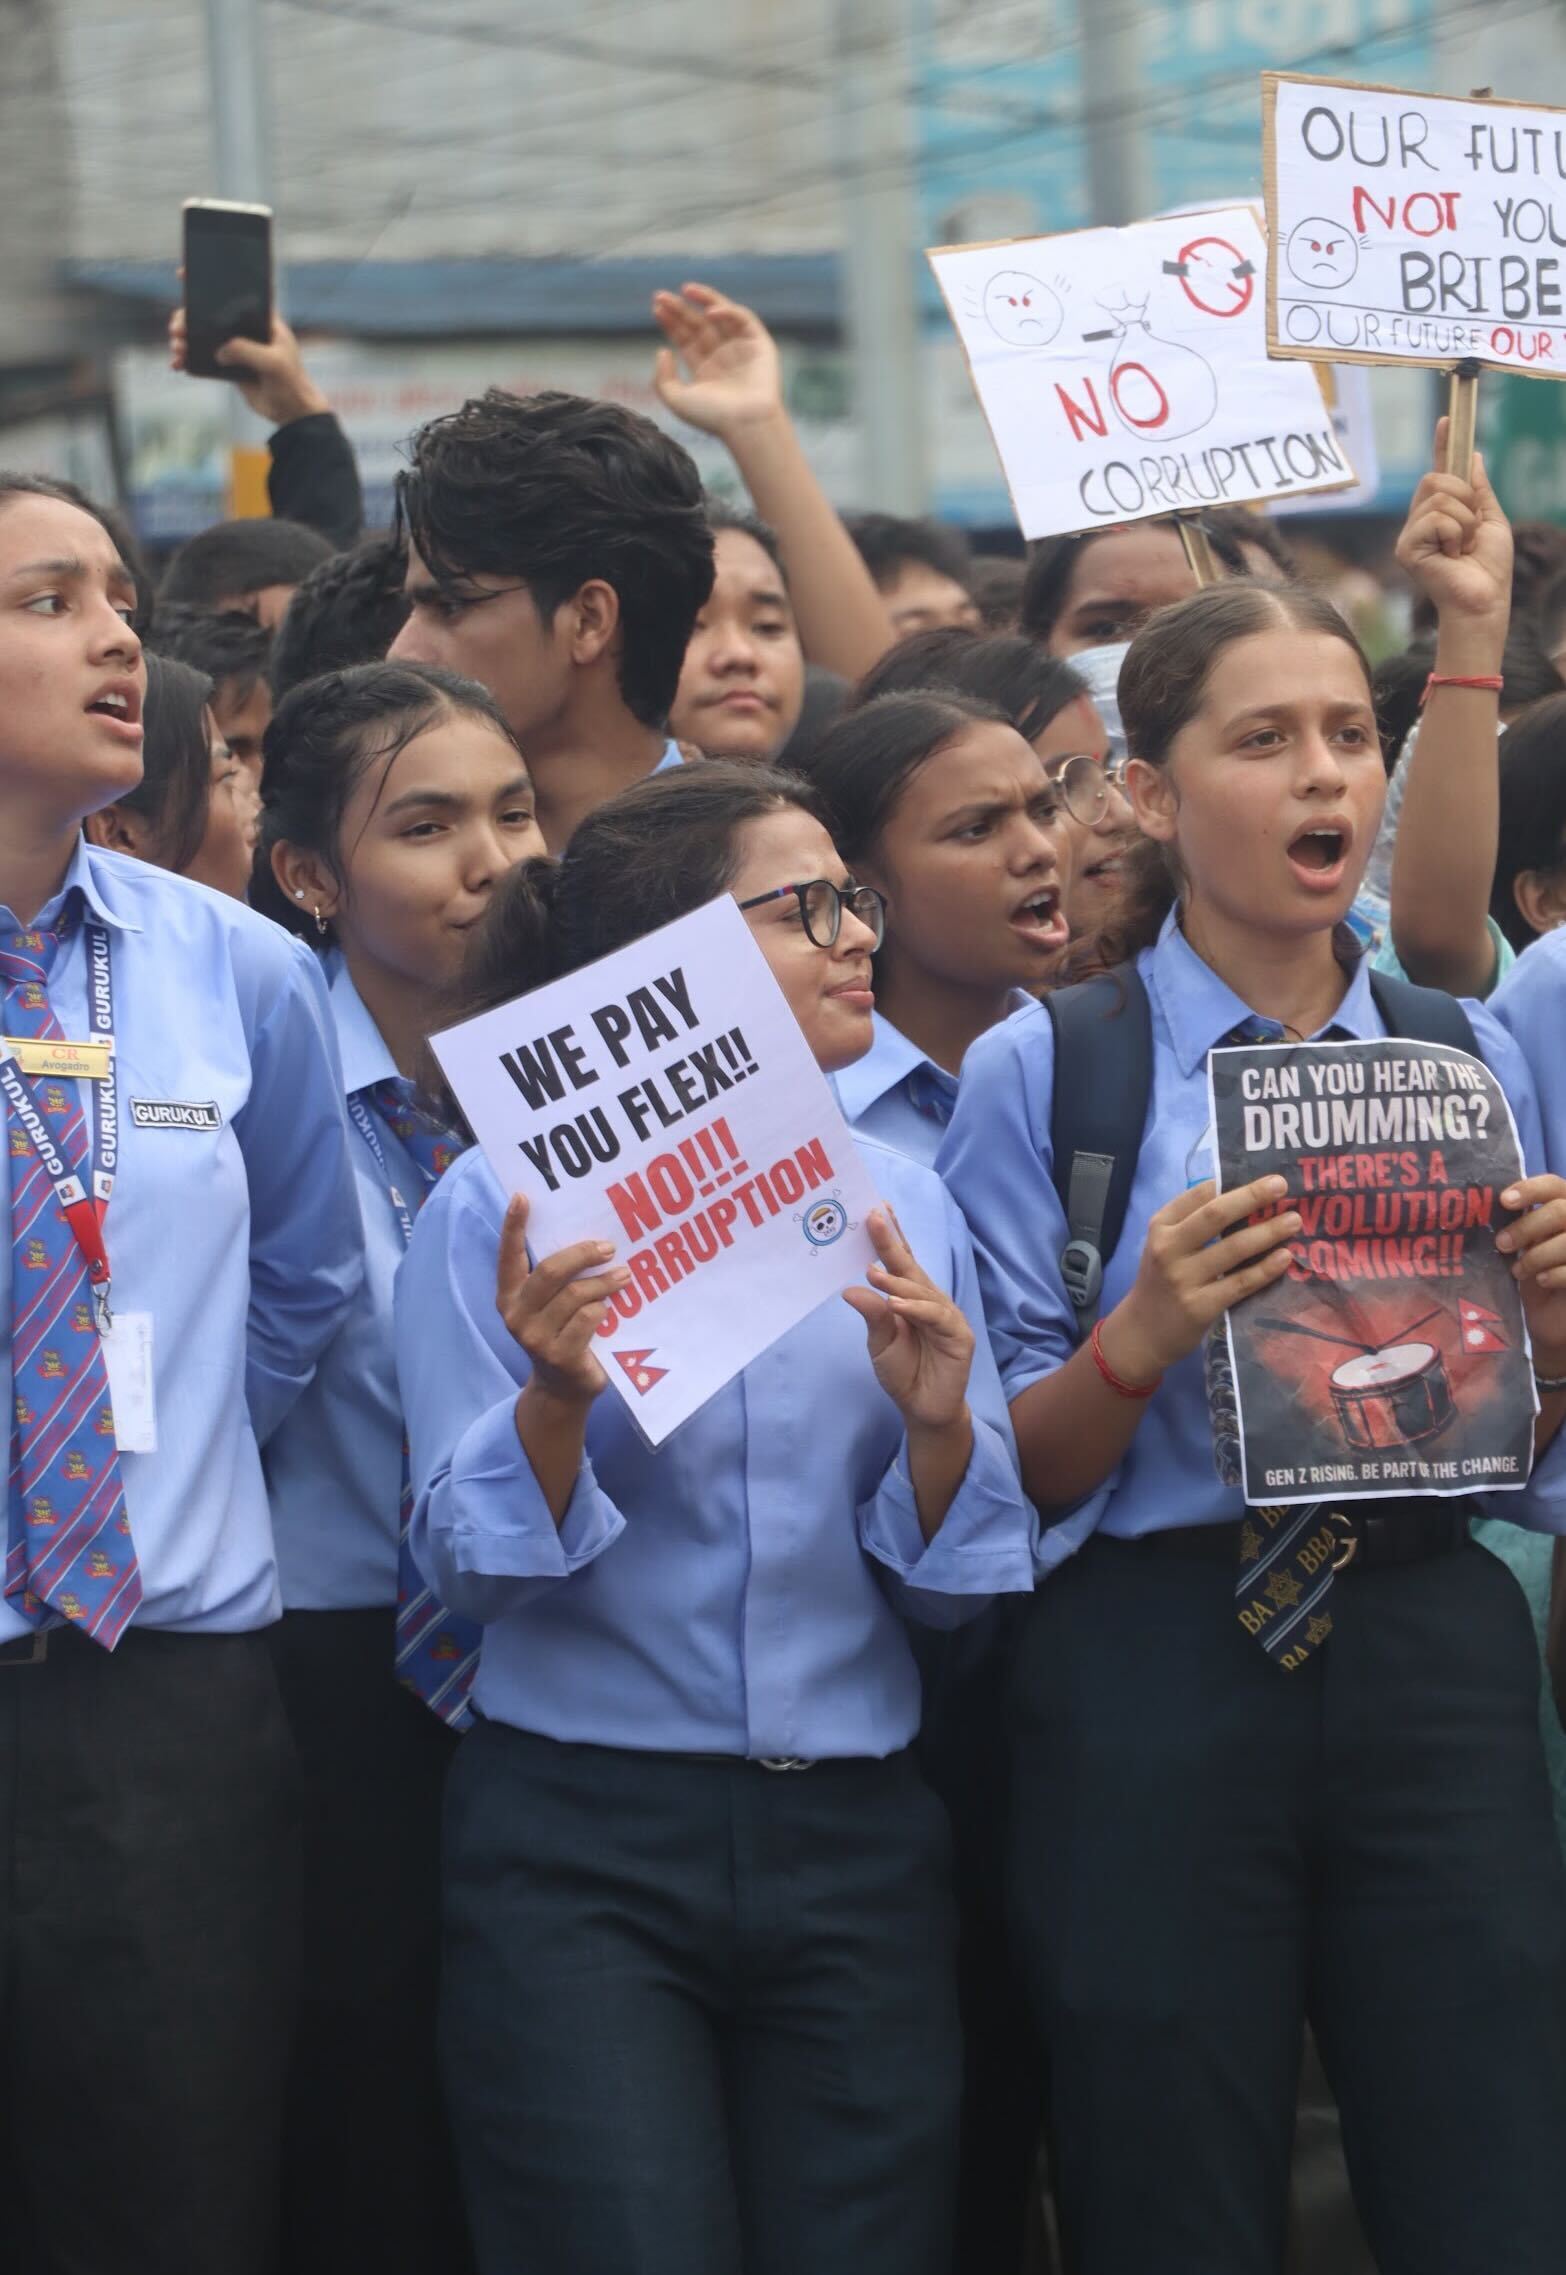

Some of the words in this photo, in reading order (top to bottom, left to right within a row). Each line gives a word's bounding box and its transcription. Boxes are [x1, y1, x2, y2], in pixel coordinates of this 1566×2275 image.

[1301, 106, 1440, 172] OUR
[1353, 186, 1461, 237] NOT
[1400, 251, 1562, 320] BRIBE
[1286, 304, 1381, 347] OUR
[1390, 318, 1482, 352] FUTURE
[1490, 326, 1553, 361] OUR
[1053, 362, 1169, 442] NO
[1079, 431, 1344, 515] CORRUPTION
[92, 930, 112, 1030] GURUKUL
[41, 1060, 90, 1072] Avogadro
[51, 1047, 80, 1060] CR
[499, 1024, 600, 1111] WE
[590, 967, 700, 1069] PAY
[1242, 1066, 1300, 1100] CAN
[1308, 1063, 1364, 1096] YOU
[1374, 1060, 1440, 1093] HEAR
[1439, 1060, 1486, 1090] THE
[1, 1066, 64, 1176] GURUKUL
[135, 1104, 217, 1125] GURUKUL
[518, 1106, 621, 1192] YOU
[617, 1026, 760, 1142] FLEX!!
[1243, 1094, 1490, 1151] DRUMMING?
[605, 1116, 749, 1243] NO!!!
[1297, 1152, 1420, 1191] THERE'S
[1428, 1151, 1448, 1185] A
[1247, 1187, 1493, 1238] VOLUTION
[1287, 1234, 1465, 1281] COMING!!
[1265, 1469, 1294, 1486] GEN
[1298, 1469, 1307, 1484] Z
[1311, 1464, 1358, 1483] RISING.
[1362, 1463, 1379, 1479] BE
[1383, 1462, 1416, 1478] PART
[1432, 1462, 1458, 1479] THE
[1462, 1456, 1519, 1476] CHANGE.
